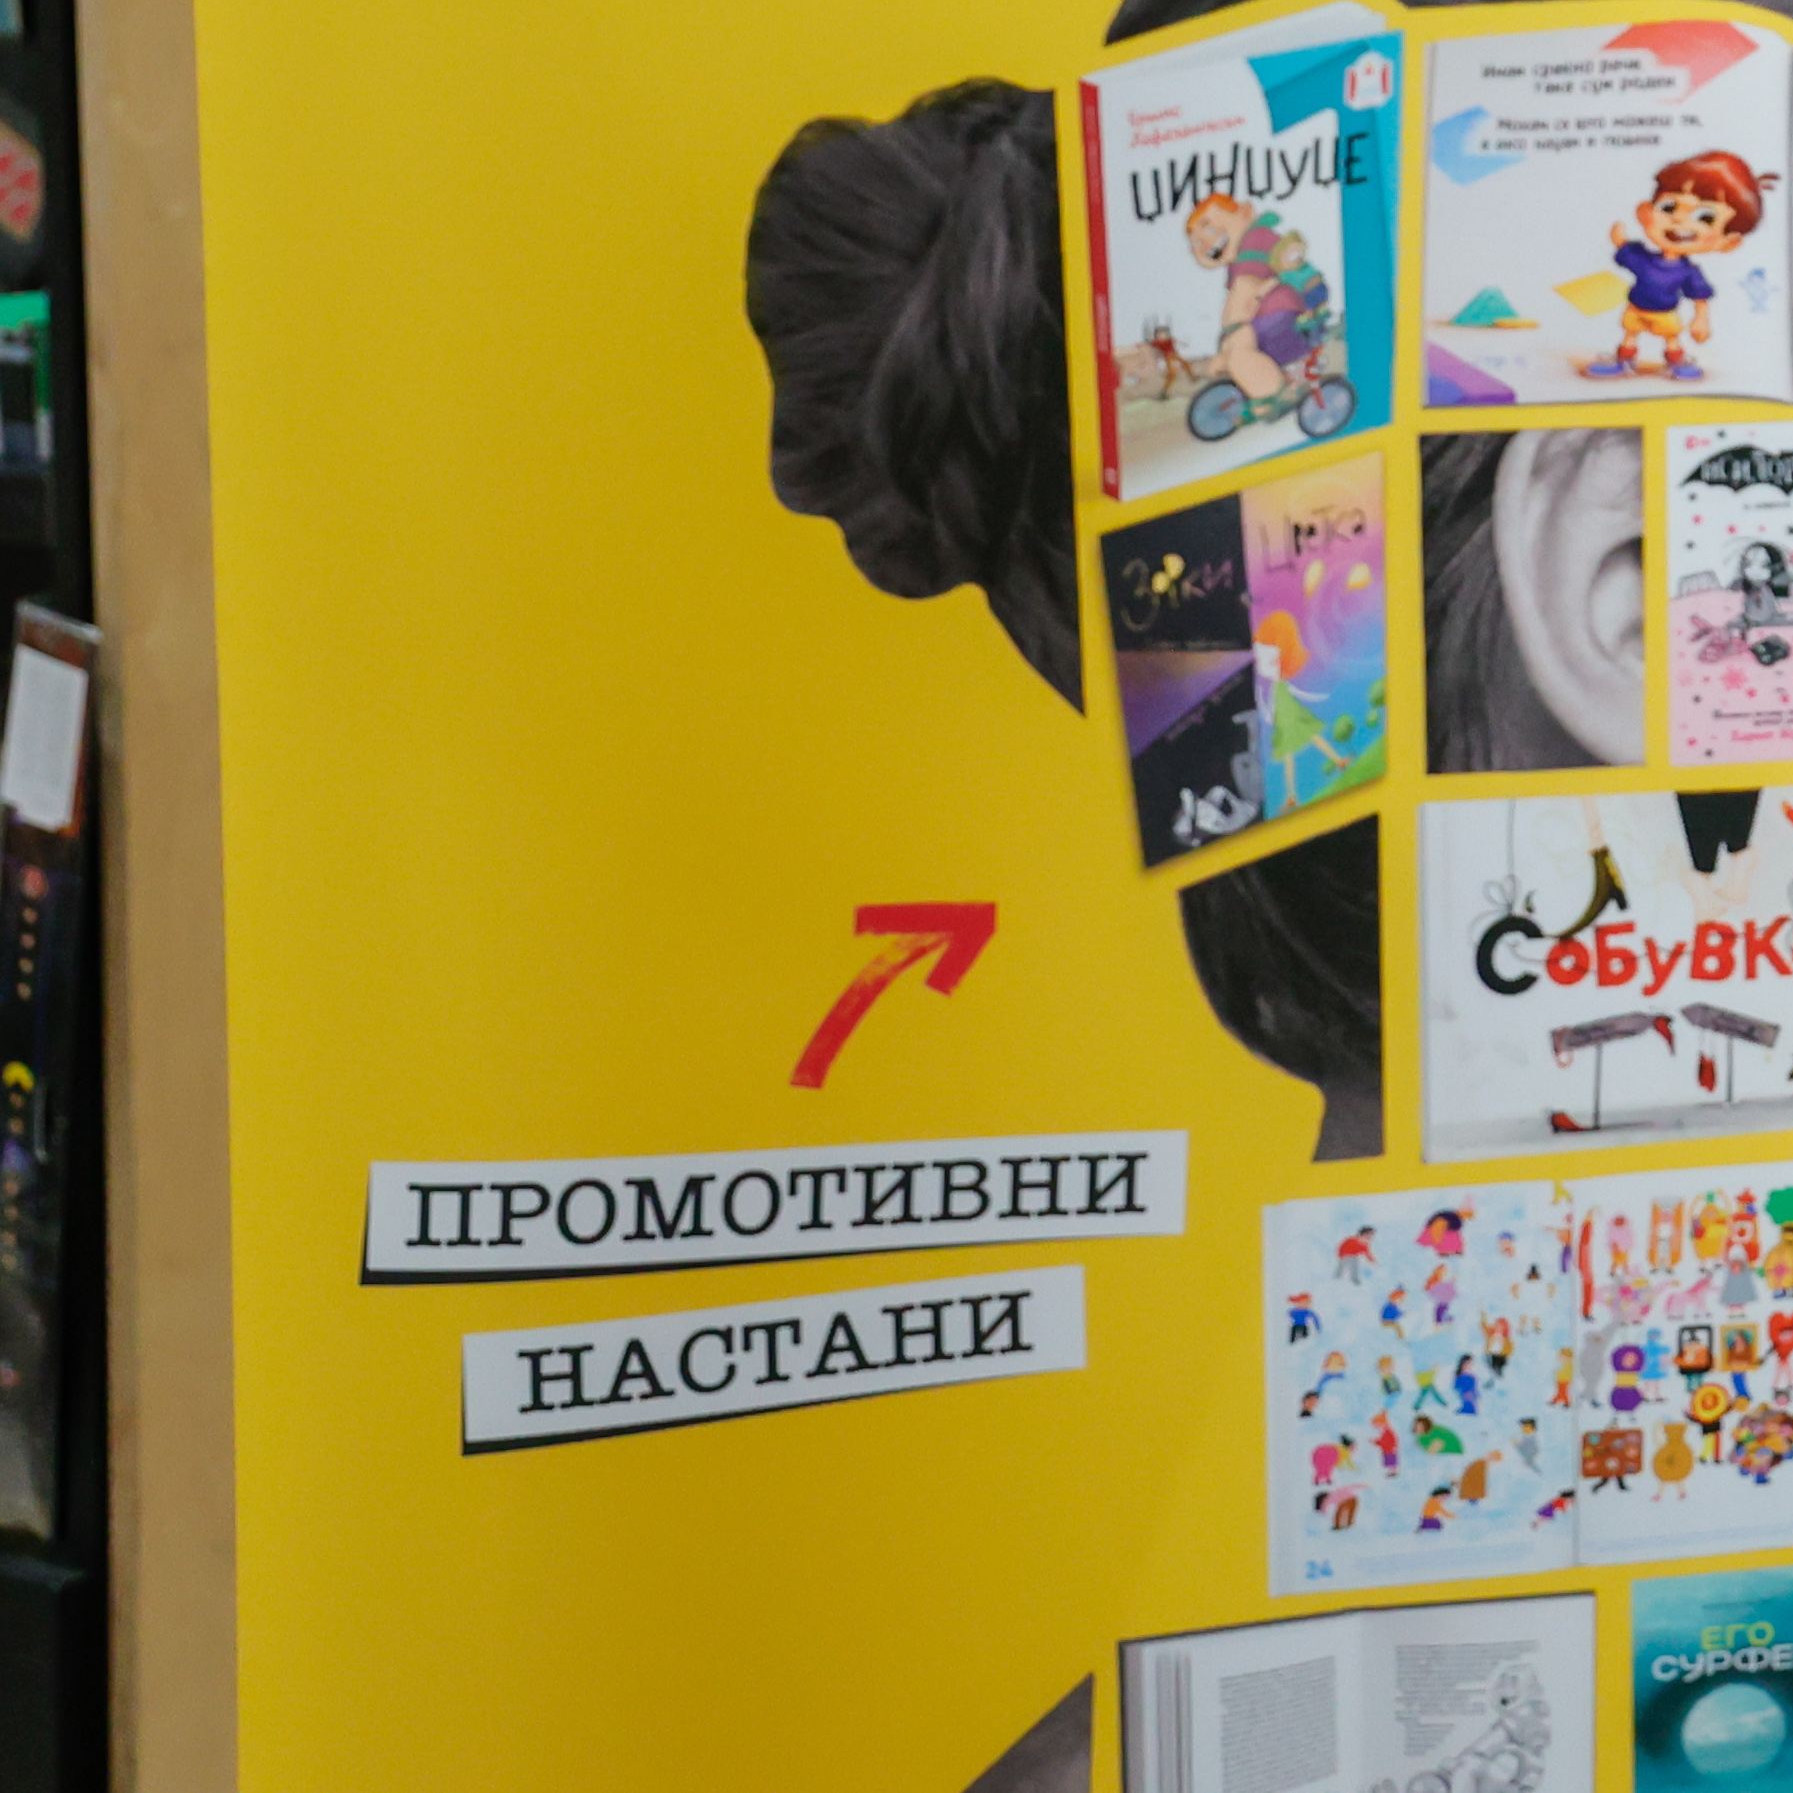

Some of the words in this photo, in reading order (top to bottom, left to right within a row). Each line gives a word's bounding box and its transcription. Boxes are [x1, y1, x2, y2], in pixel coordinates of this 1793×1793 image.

[405, 1151, 1151, 1249] ПРОМОТИВНИ
[516, 1289, 1035, 1415] НАСТАНИ
[1699, 1620, 1777, 1651] ЕГО
